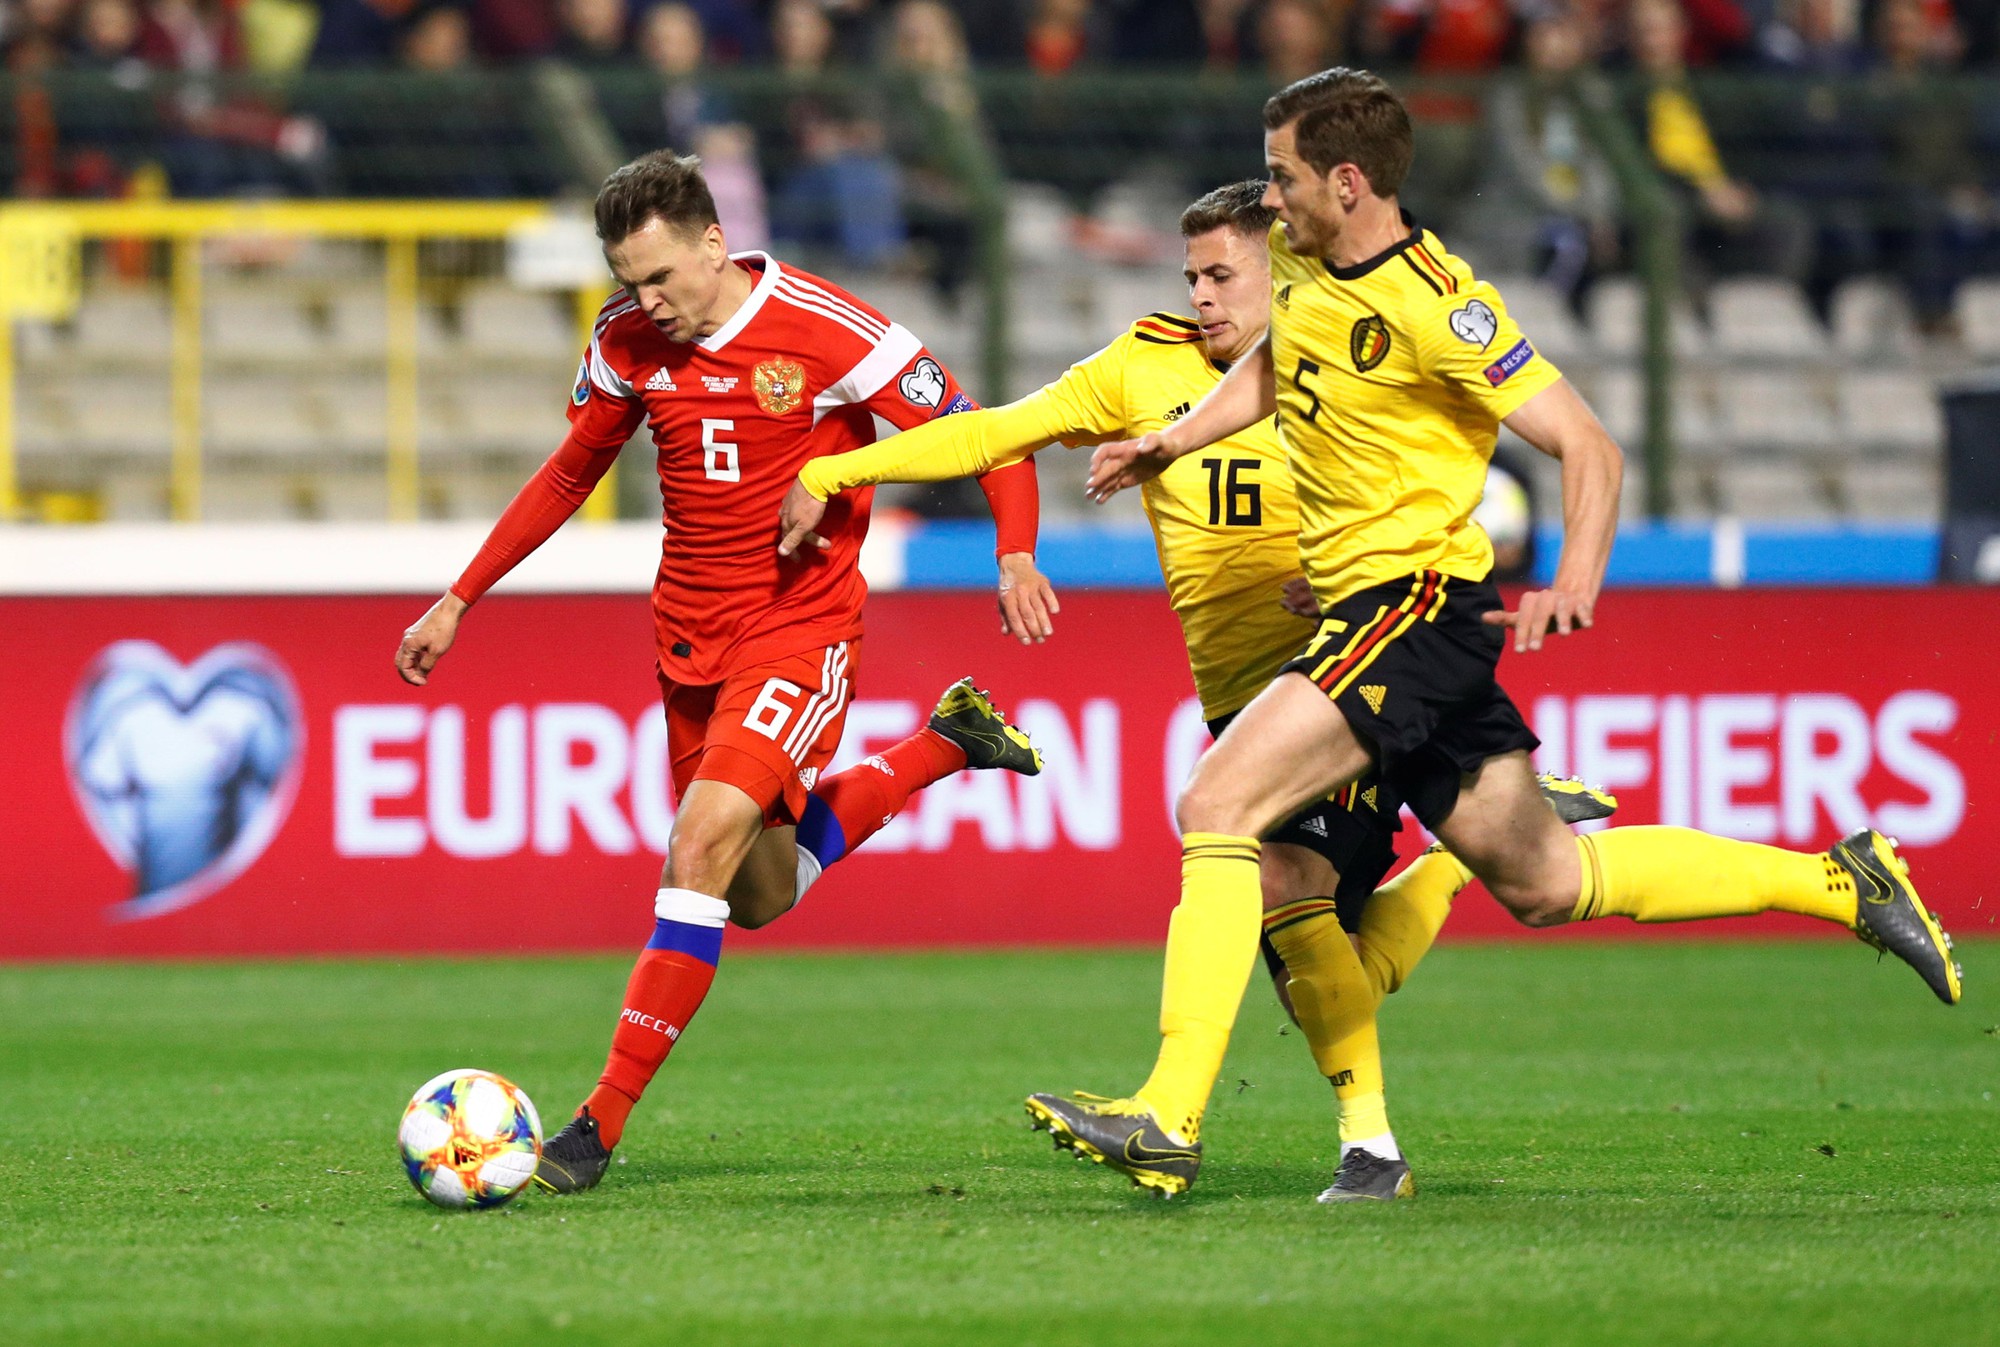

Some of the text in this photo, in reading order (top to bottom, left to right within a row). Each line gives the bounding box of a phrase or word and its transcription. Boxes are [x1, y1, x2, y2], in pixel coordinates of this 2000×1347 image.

[645, 381, 677, 391] adidas
[1294, 358, 1320, 422] 5
[702, 418, 740, 482] 6
[1202, 458, 1261, 526] 16
[741, 677, 802, 741] 6
[1300, 824, 1328, 837] adidas
[620, 1008, 680, 1041] РОССИЯ
